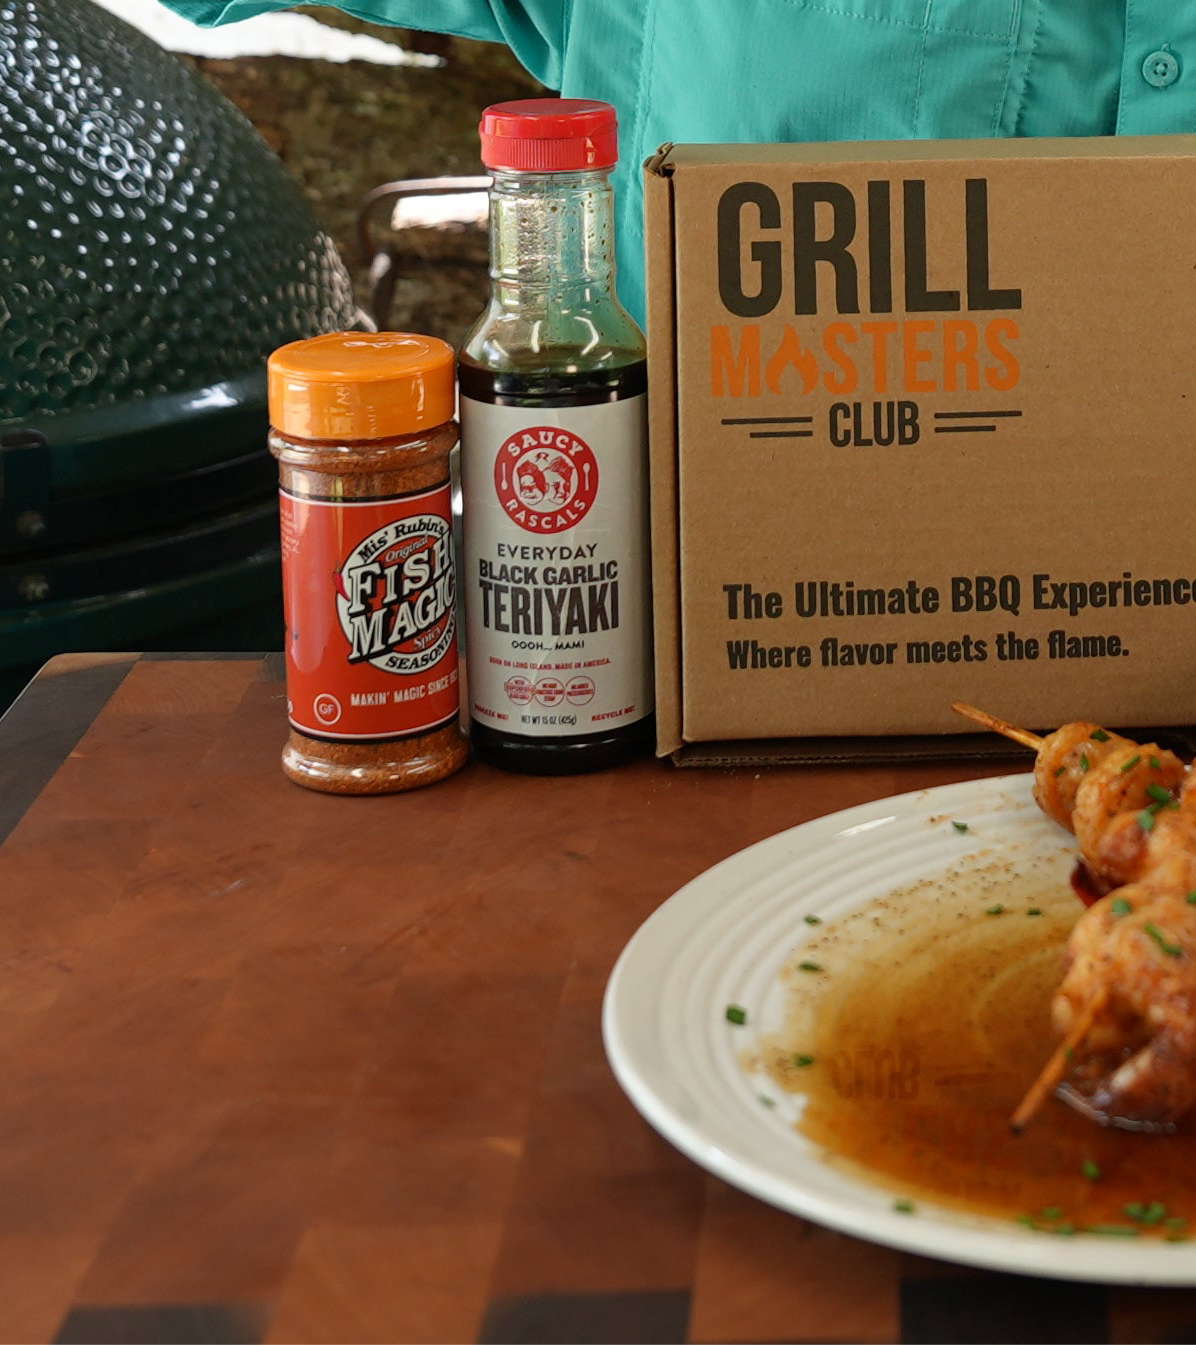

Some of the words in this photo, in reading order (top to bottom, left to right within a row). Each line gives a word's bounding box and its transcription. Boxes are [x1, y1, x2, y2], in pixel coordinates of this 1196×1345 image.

[717, 178, 1022, 318] GRILL
[829, 400, 920, 448] CLUB
[507, 431, 584, 457] SAUCY
[506, 499, 586, 529] RASCALS
[358, 531, 389, 564] Mis'
[394, 518, 444, 539] Rubin's
[385, 534, 428, 562] Original
[497, 543, 598, 561] EVERYDAY
[348, 530, 450, 614] FISH
[479, 558, 539, 585] BLACK
[543, 560, 618, 585] GARLIC
[479, 580, 619, 636] TERIYAKI
[723, 583, 783, 620] The
[795, 579, 940, 619] Ultimate
[951, 574, 1022, 617] BBQ
[348, 565, 456, 661] MAGIC
[555, 640, 585, 651] MAMI
[726, 639, 812, 670] Where
[820, 637, 898, 668] flavor
[906, 633, 988, 665] meets
[995, 630, 1040, 662] the
[1048, 630, 1130, 660] flame.
[513, 661, 528, 669] LONG
[350, 691, 390, 706] MAKIN'
[393, 684, 425, 703] MAGIC
[427, 674, 449, 695] SINCE
[318, 703, 335, 715] GF
[521, 715, 530, 724] NET
[592, 708, 623, 721] RECYCLE
